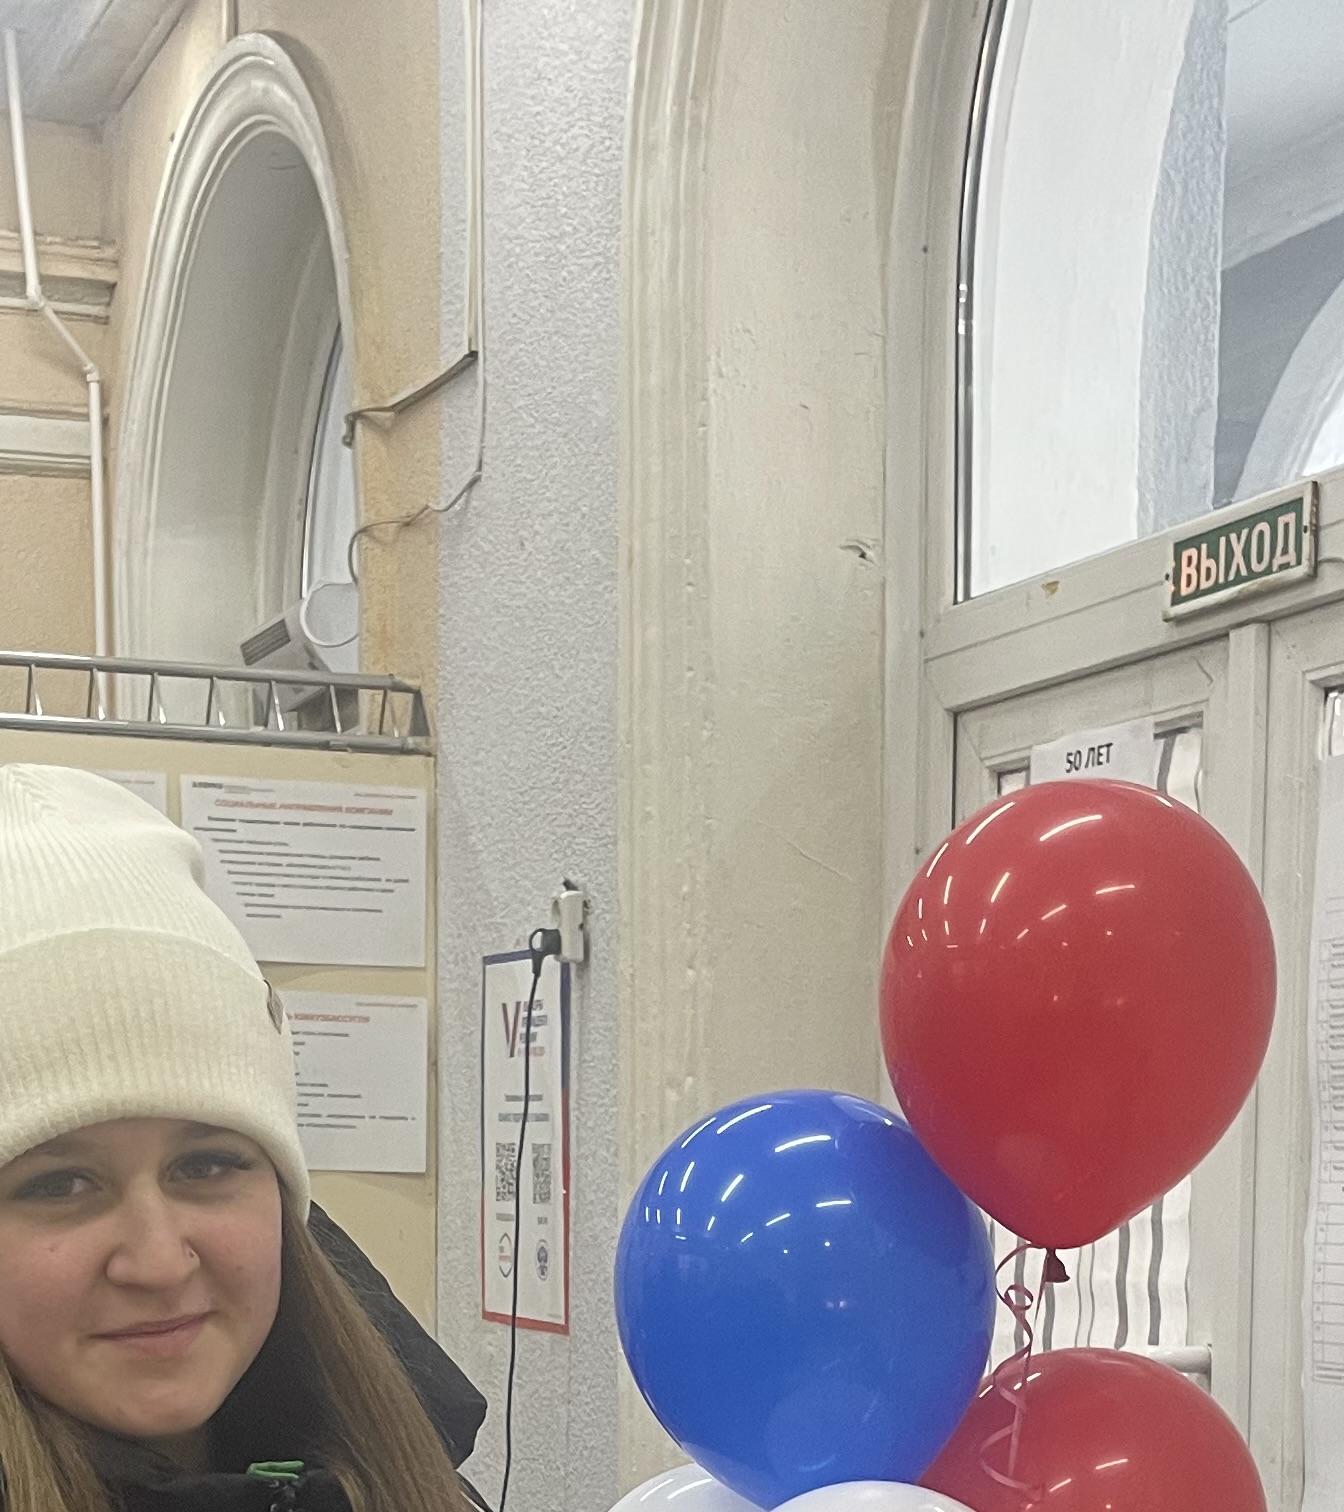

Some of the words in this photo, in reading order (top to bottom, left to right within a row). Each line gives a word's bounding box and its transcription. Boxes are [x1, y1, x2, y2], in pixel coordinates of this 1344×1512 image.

[1180, 512, 1297, 597] ВЫХОД
[1066, 750, 1082, 773] 50
[1085, 743, 1113, 768] ЛЕТ
